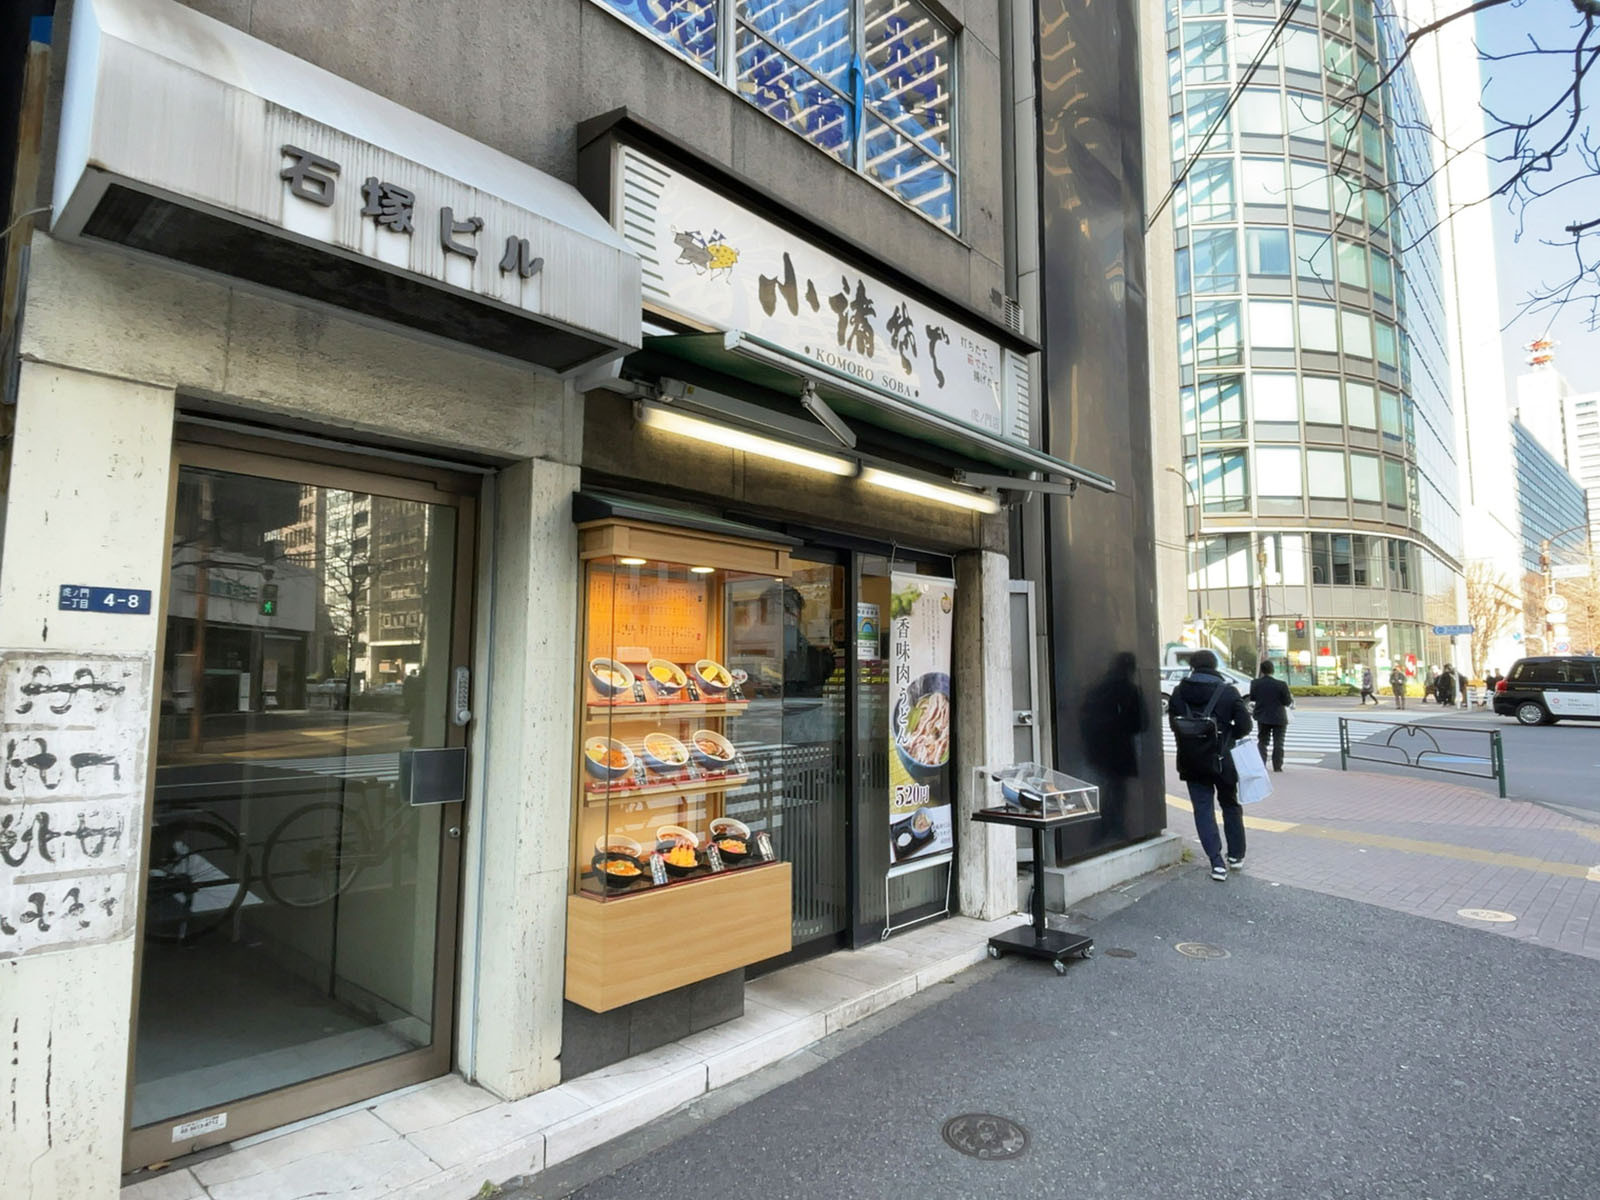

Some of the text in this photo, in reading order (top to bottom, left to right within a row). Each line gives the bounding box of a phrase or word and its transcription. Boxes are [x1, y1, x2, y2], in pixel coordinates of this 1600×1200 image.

[280, 144, 545, 279] 石塚ビル
[816, 347, 912, 398] KOMORO SOBA
[61, 598, 89, 609] 一丁目
[62, 587, 90, 599] 虎ノ門
[103, 592, 140, 609] 4-8
[895, 617, 911, 745] 香味肉うどん
[895, 783, 930, 807] 520円
